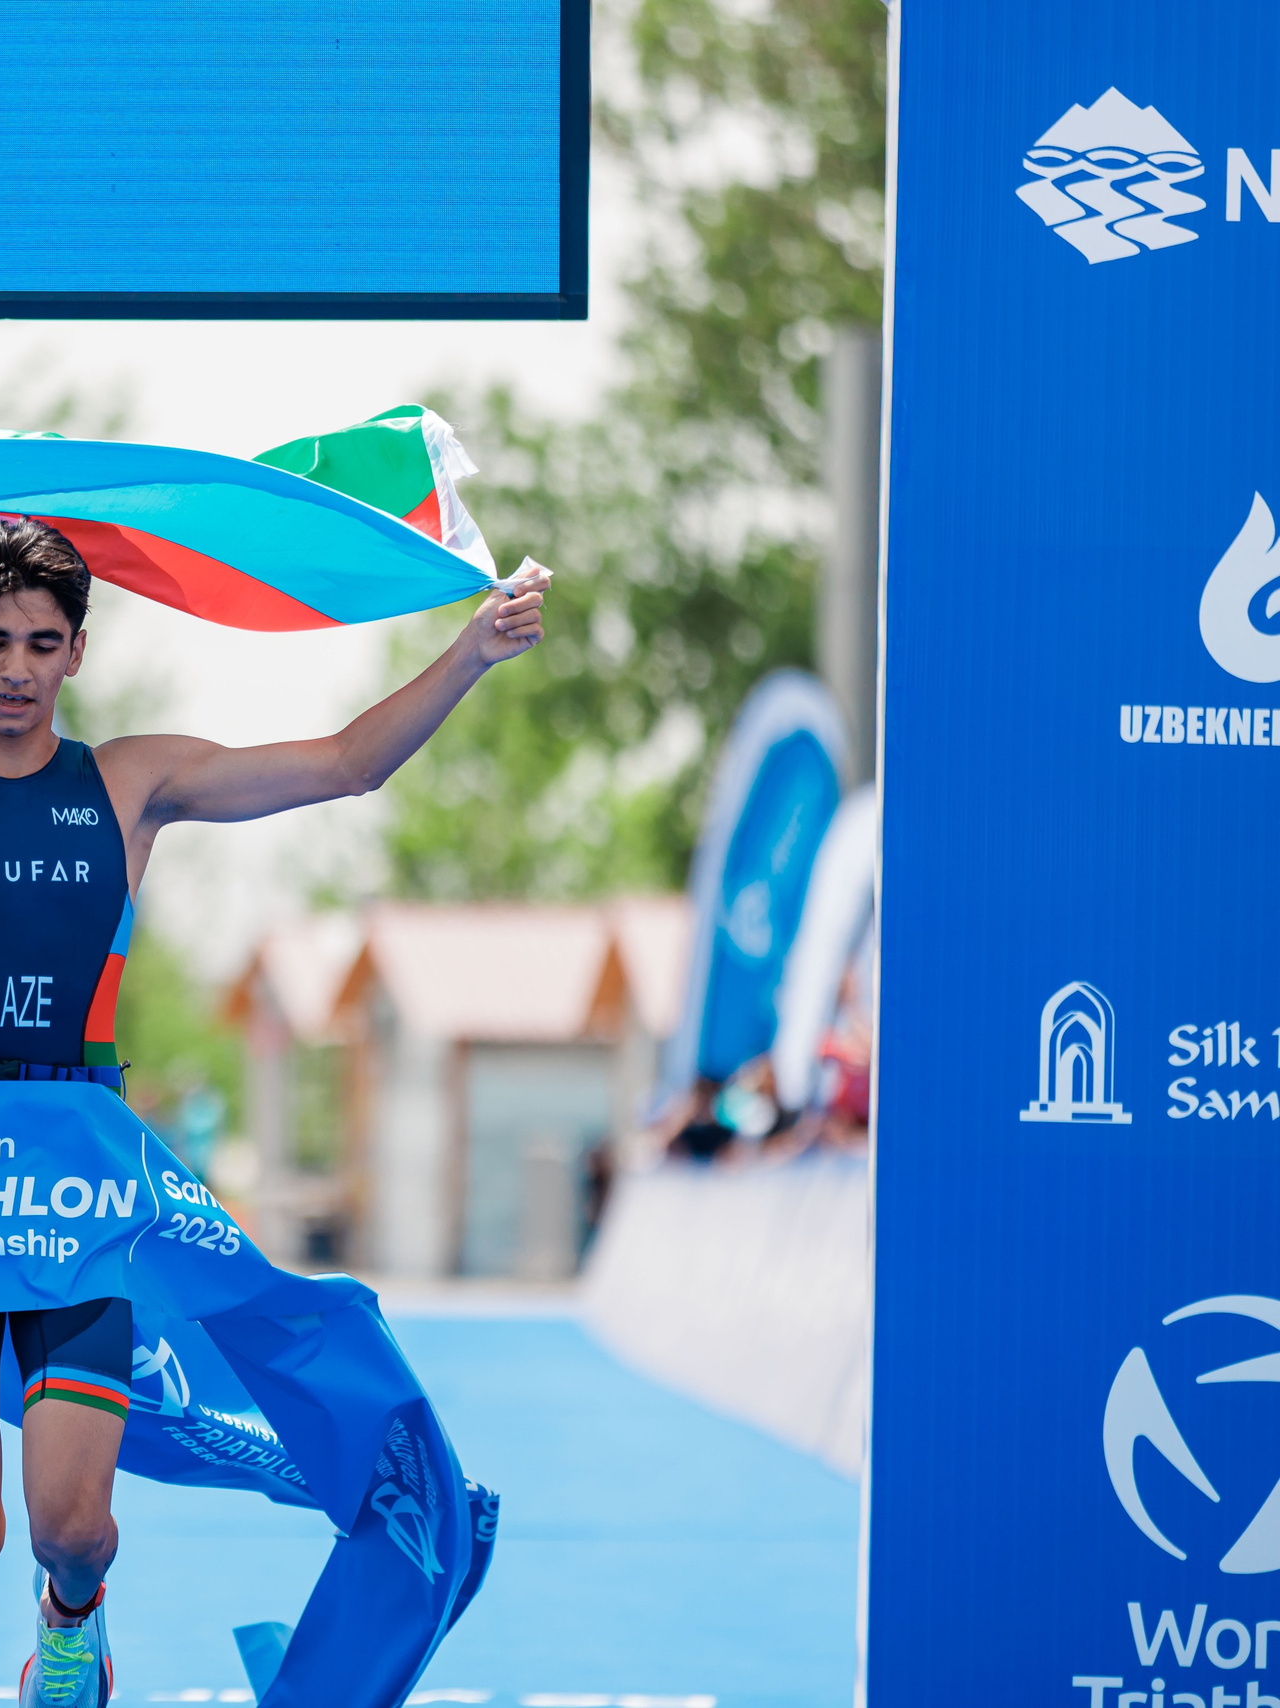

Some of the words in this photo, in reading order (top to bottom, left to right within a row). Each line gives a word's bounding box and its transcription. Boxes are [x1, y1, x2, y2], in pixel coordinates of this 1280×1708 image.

[0, 975, 53, 1028] AZE
[1167, 1020, 1261, 1068] Silk
[1166, 1076, 1280, 1121] Sam
[158, 1212, 240, 1256] 2025
[198, 1404, 284, 1449] UZBEKIST
